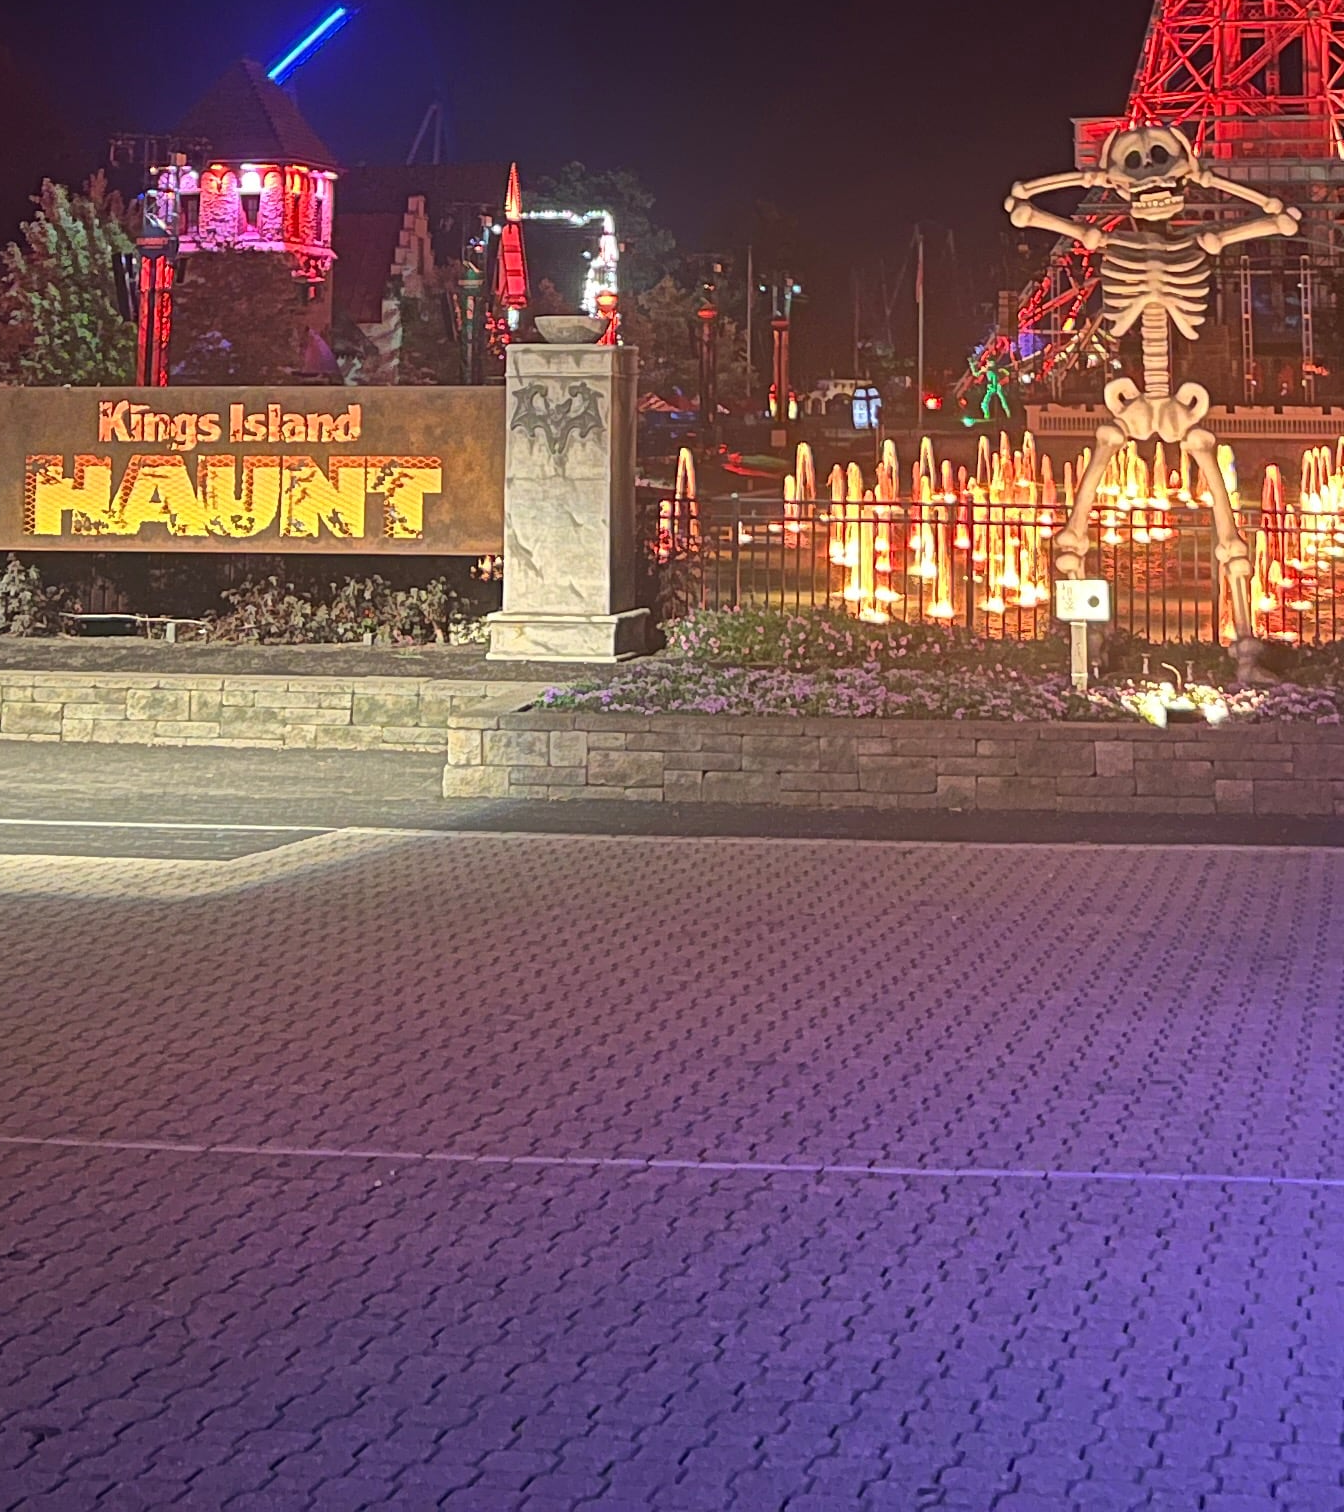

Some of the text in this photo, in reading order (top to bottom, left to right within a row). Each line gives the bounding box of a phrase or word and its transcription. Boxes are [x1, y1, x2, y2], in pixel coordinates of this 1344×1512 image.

[98, 399, 361, 451] Kings Island
[24, 454, 442, 539] HAUNT
